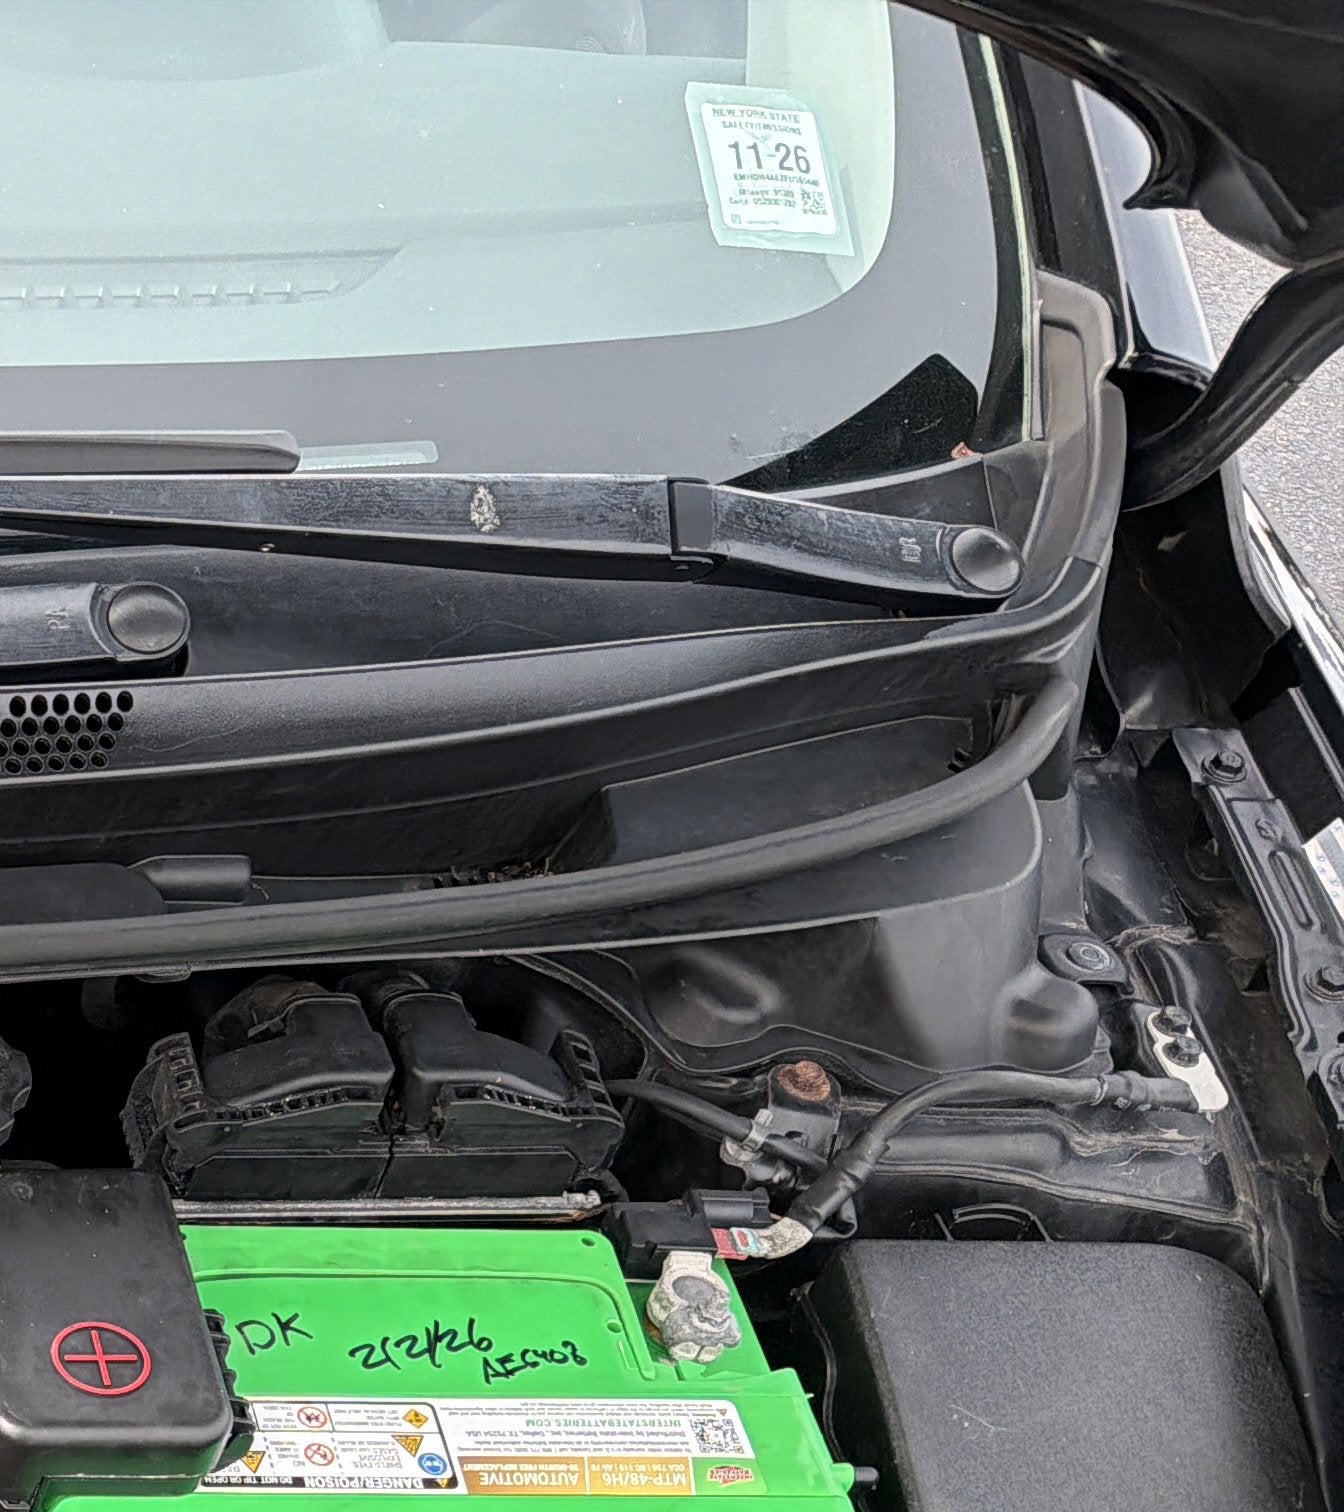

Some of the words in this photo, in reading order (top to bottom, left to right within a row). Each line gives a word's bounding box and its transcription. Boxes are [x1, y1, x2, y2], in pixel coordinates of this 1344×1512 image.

[712, 107, 736, 118] NEW
[738, 109, 767, 120] YORK
[769, 112, 800, 123] STATE
[728, 140, 811, 175] 11-26
[234, 1311, 314, 1357] DK
[525, 1419, 682, 1427] INTERSTATEBATTERIES.COM
[260, 1476, 279, 1484] NOT
[303, 1476, 424, 1489] DANGER/POISON
[478, 1472, 579, 1486] AUTOMOTIVE
[601, 1472, 687, 1486] MTP-48/H6
